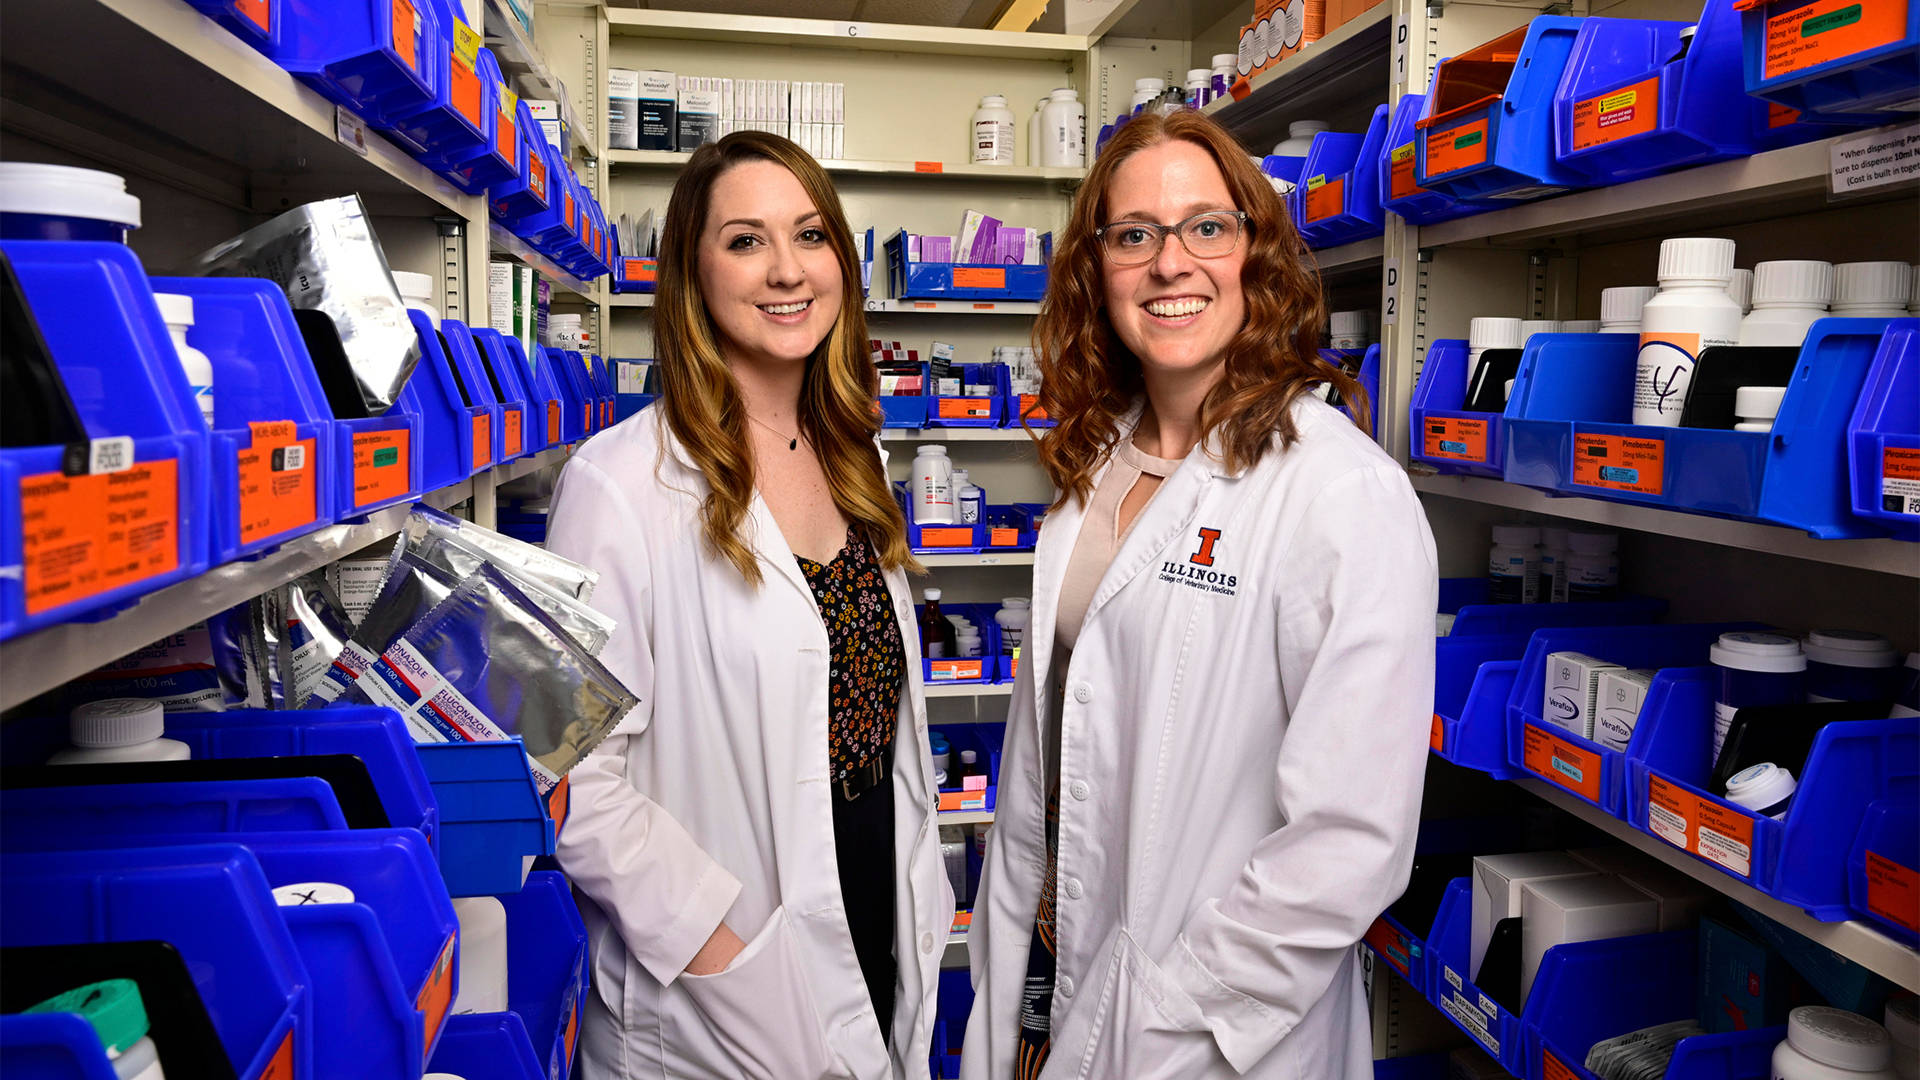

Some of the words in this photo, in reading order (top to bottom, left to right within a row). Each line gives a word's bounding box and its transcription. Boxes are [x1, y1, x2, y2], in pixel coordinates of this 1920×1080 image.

[1769, 7, 1814, 29] Pantoprazole
[848, 26, 857, 36] C
[1398, 24, 1407, 45] D
[1397, 55, 1404, 73] 1
[1867, 138, 1905, 154] dispensing
[1835, 166, 1850, 176] sure
[1852, 163, 1859, 171] to
[1861, 156, 1893, 169] dispense
[1847, 176, 1865, 187] (Cost
[1874, 168, 1891, 179] built
[1893, 167, 1899, 175] in
[1388, 268, 1397, 286] D
[867, 301, 876, 311] C
[1387, 297, 1395, 315] 2
[1622, 440, 1656, 449] Pimobendan
[1189, 527, 1222, 567] I
[1161, 562, 1237, 587] ILLINOIS
[1158, 573, 1176, 583] College
[1185, 578, 1210, 592] Veterinary
[1211, 585, 1235, 596] Medicine
[385, 667, 398, 681] 100
[191, 692, 222, 704] DILUENT
[1549, 697, 1574, 713] Veraflox
[438, 689, 492, 738] FLUCONAZOLE
[440, 698, 460, 719] SODIUM
[421, 704, 435, 717] 200
[433, 714, 443, 726] mg
[441, 721, 451, 732] per
[449, 728, 462, 741] 100
[1601, 717, 1629, 737] Veraflox
[1700, 842, 1728, 858] EXPIRATION
[1706, 850, 1719, 860] DATE
[1441, 996, 1461, 1020] CARDIO
[1461, 1014, 1482, 1038] REPAIR
